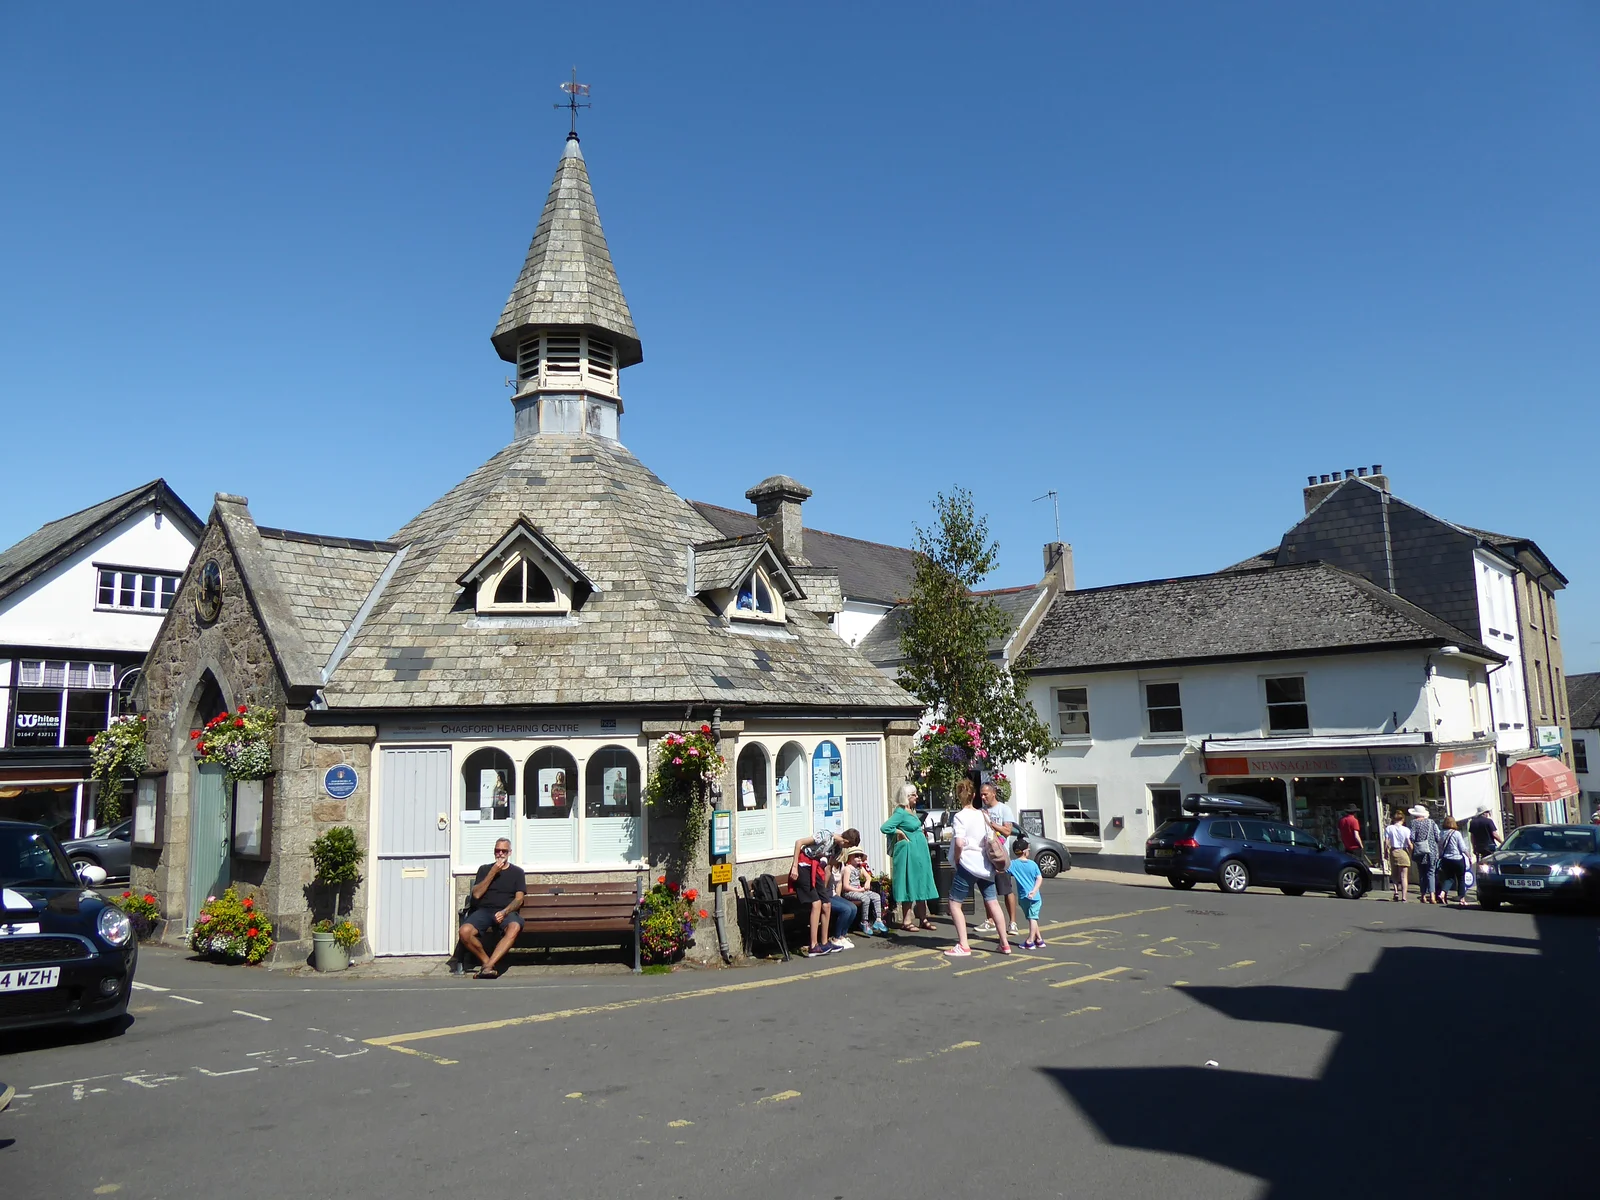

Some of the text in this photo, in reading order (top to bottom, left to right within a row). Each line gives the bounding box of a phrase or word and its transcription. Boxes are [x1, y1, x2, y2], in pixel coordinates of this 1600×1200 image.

[17, 714, 59, 727] Whites
[441, 725, 494, 734] CHAGFORD
[497, 724, 539, 733] HEARING
[541, 723, 579, 732] CENTRE
[1251, 760, 1338, 771] NEWSAGENTS
[17, 969, 52, 987] WZH
